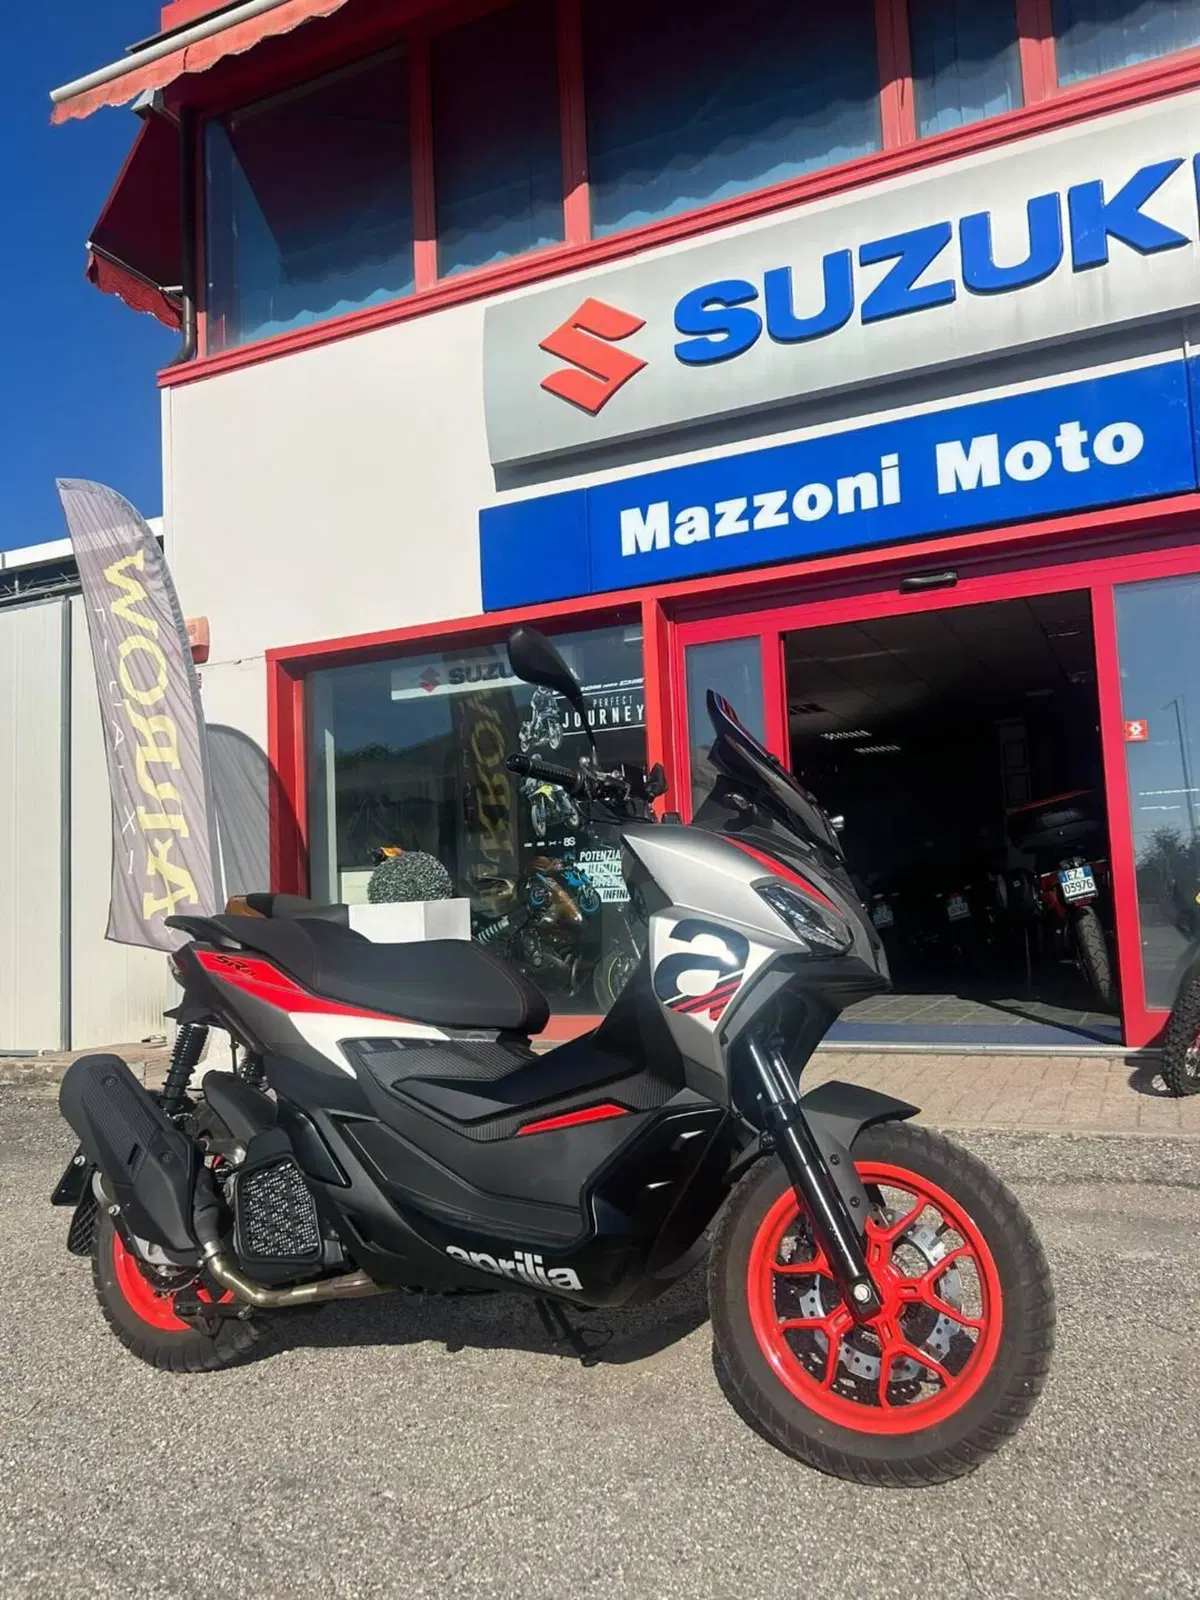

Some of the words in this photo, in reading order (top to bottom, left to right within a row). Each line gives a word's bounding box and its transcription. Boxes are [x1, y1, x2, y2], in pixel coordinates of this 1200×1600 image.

[673, 153, 1200, 367] SUZUK
[619, 454, 901, 557] Mazzoni
[936, 420, 1145, 496] Moto
[562, 703, 645, 728] JOURNEY
[592, 695, 633, 708] PERFECT
[1064, 879, 1094, 895] 03976
[446, 1245, 584, 1290] aprilia
